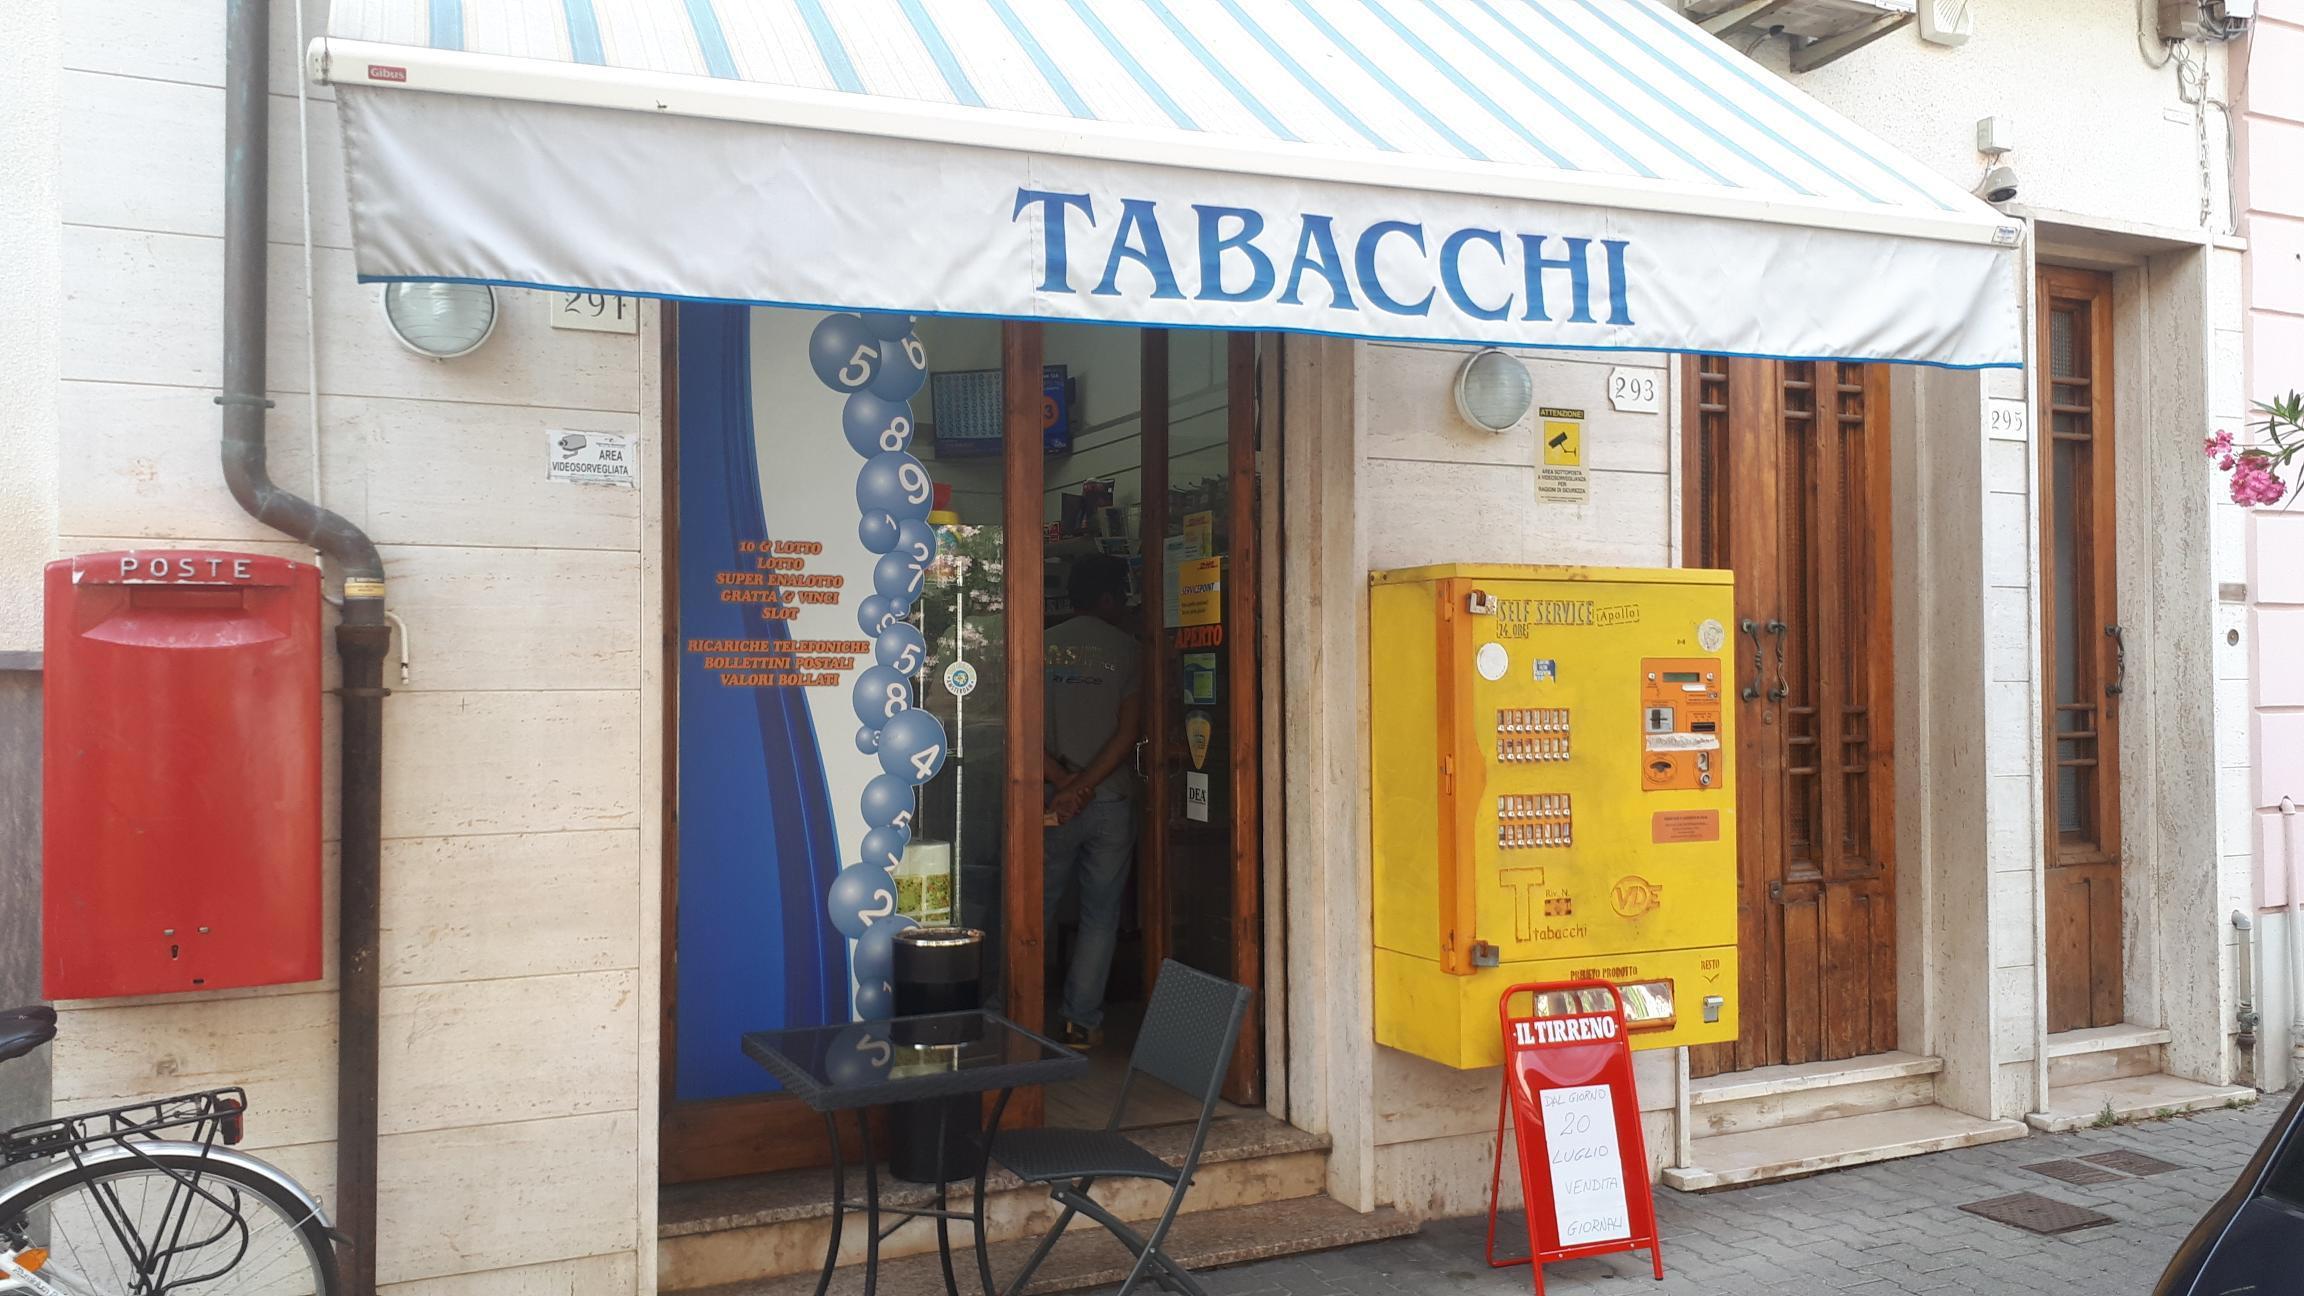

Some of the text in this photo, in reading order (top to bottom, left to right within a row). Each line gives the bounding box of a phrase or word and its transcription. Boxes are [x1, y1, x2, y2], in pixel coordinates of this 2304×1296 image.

[370, 67, 405, 80] Gibus
[1012, 187, 1635, 326] TABACCHI
[1615, 376, 1655, 401] 293
[1540, 408, 1584, 418] ATTENZIONE!
[1991, 409, 2023, 432] 295
[599, 450, 623, 461] AREA
[552, 461, 629, 476] VIDEOSORVEGLIATA
[898, 463, 930, 505] 9
[738, 541, 756, 553] 10
[774, 541, 822, 555] LOTTO
[120, 557, 252, 579] POSTE
[757, 557, 804, 571] LOTTO
[716, 572, 843, 589] SUPER ENALOTTO
[720, 590, 777, 604] GRATTA
[798, 591, 839, 605] VINCI
[762, 606, 800, 620] SLOT
[1500, 600, 1530, 623] SELF
[1536, 601, 1594, 626] SERVICE
[1600, 608, 1635, 623] Apollo
[1512, 623, 1528, 637] ORE
[687, 640, 870, 655] RICARICHE TELEFONICHE
[704, 656, 854, 671] BOLLETTINI POSTALI
[720, 673, 840, 687] VALORI BOLLATI
[910, 743, 940, 779] 4
[1189, 787, 1206, 802] DEA
[1533, 923, 1588, 942] tabacchi
[1602, 965, 1638, 978] PRODOTTO
[1700, 959, 1720, 971] RESTO
[1515, 1016, 1616, 1045] IL TIRRENO
[1544, 1088, 1606, 1107] DAL GIORNO
[1560, 1112, 1591, 1137] 20
[1552, 1145, 1609, 1165] LUGLIO
[1564, 1177, 1618, 1195] VENDITA
[1567, 1217, 1623, 1236] GIORNALI
